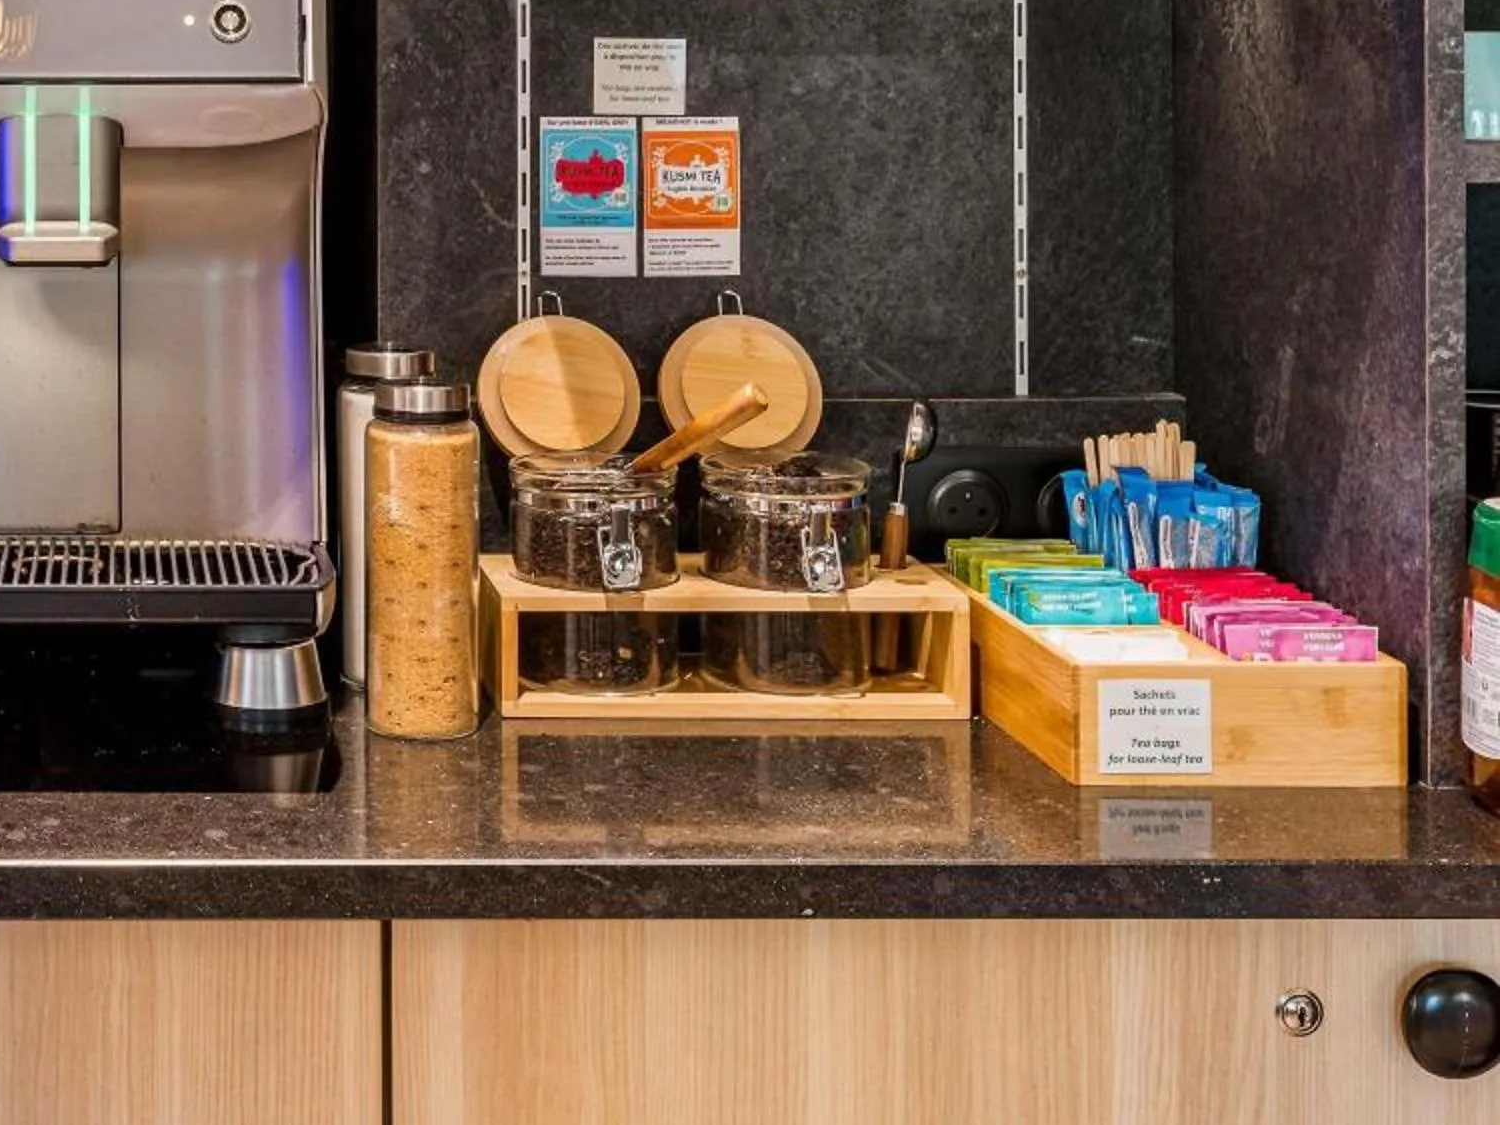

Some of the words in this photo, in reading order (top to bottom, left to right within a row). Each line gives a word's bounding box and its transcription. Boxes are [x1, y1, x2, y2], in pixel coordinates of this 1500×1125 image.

[662, 171, 697, 184] KUSMI
[702, 170, 721, 184] TEA
[1133, 690, 1176, 700] Sachets
[1109, 708, 1135, 719] pour
[1139, 706, 1157, 716] thé
[1159, 708, 1175, 716] en
[1177, 707, 1200, 716] vrac
[1131, 738, 1151, 748] Tea
[1153, 737, 1181, 749] bags
[1107, 754, 1126, 767] for
[1127, 754, 1182, 766] loose-leaf
[1185, 755, 1203, 764] tea
